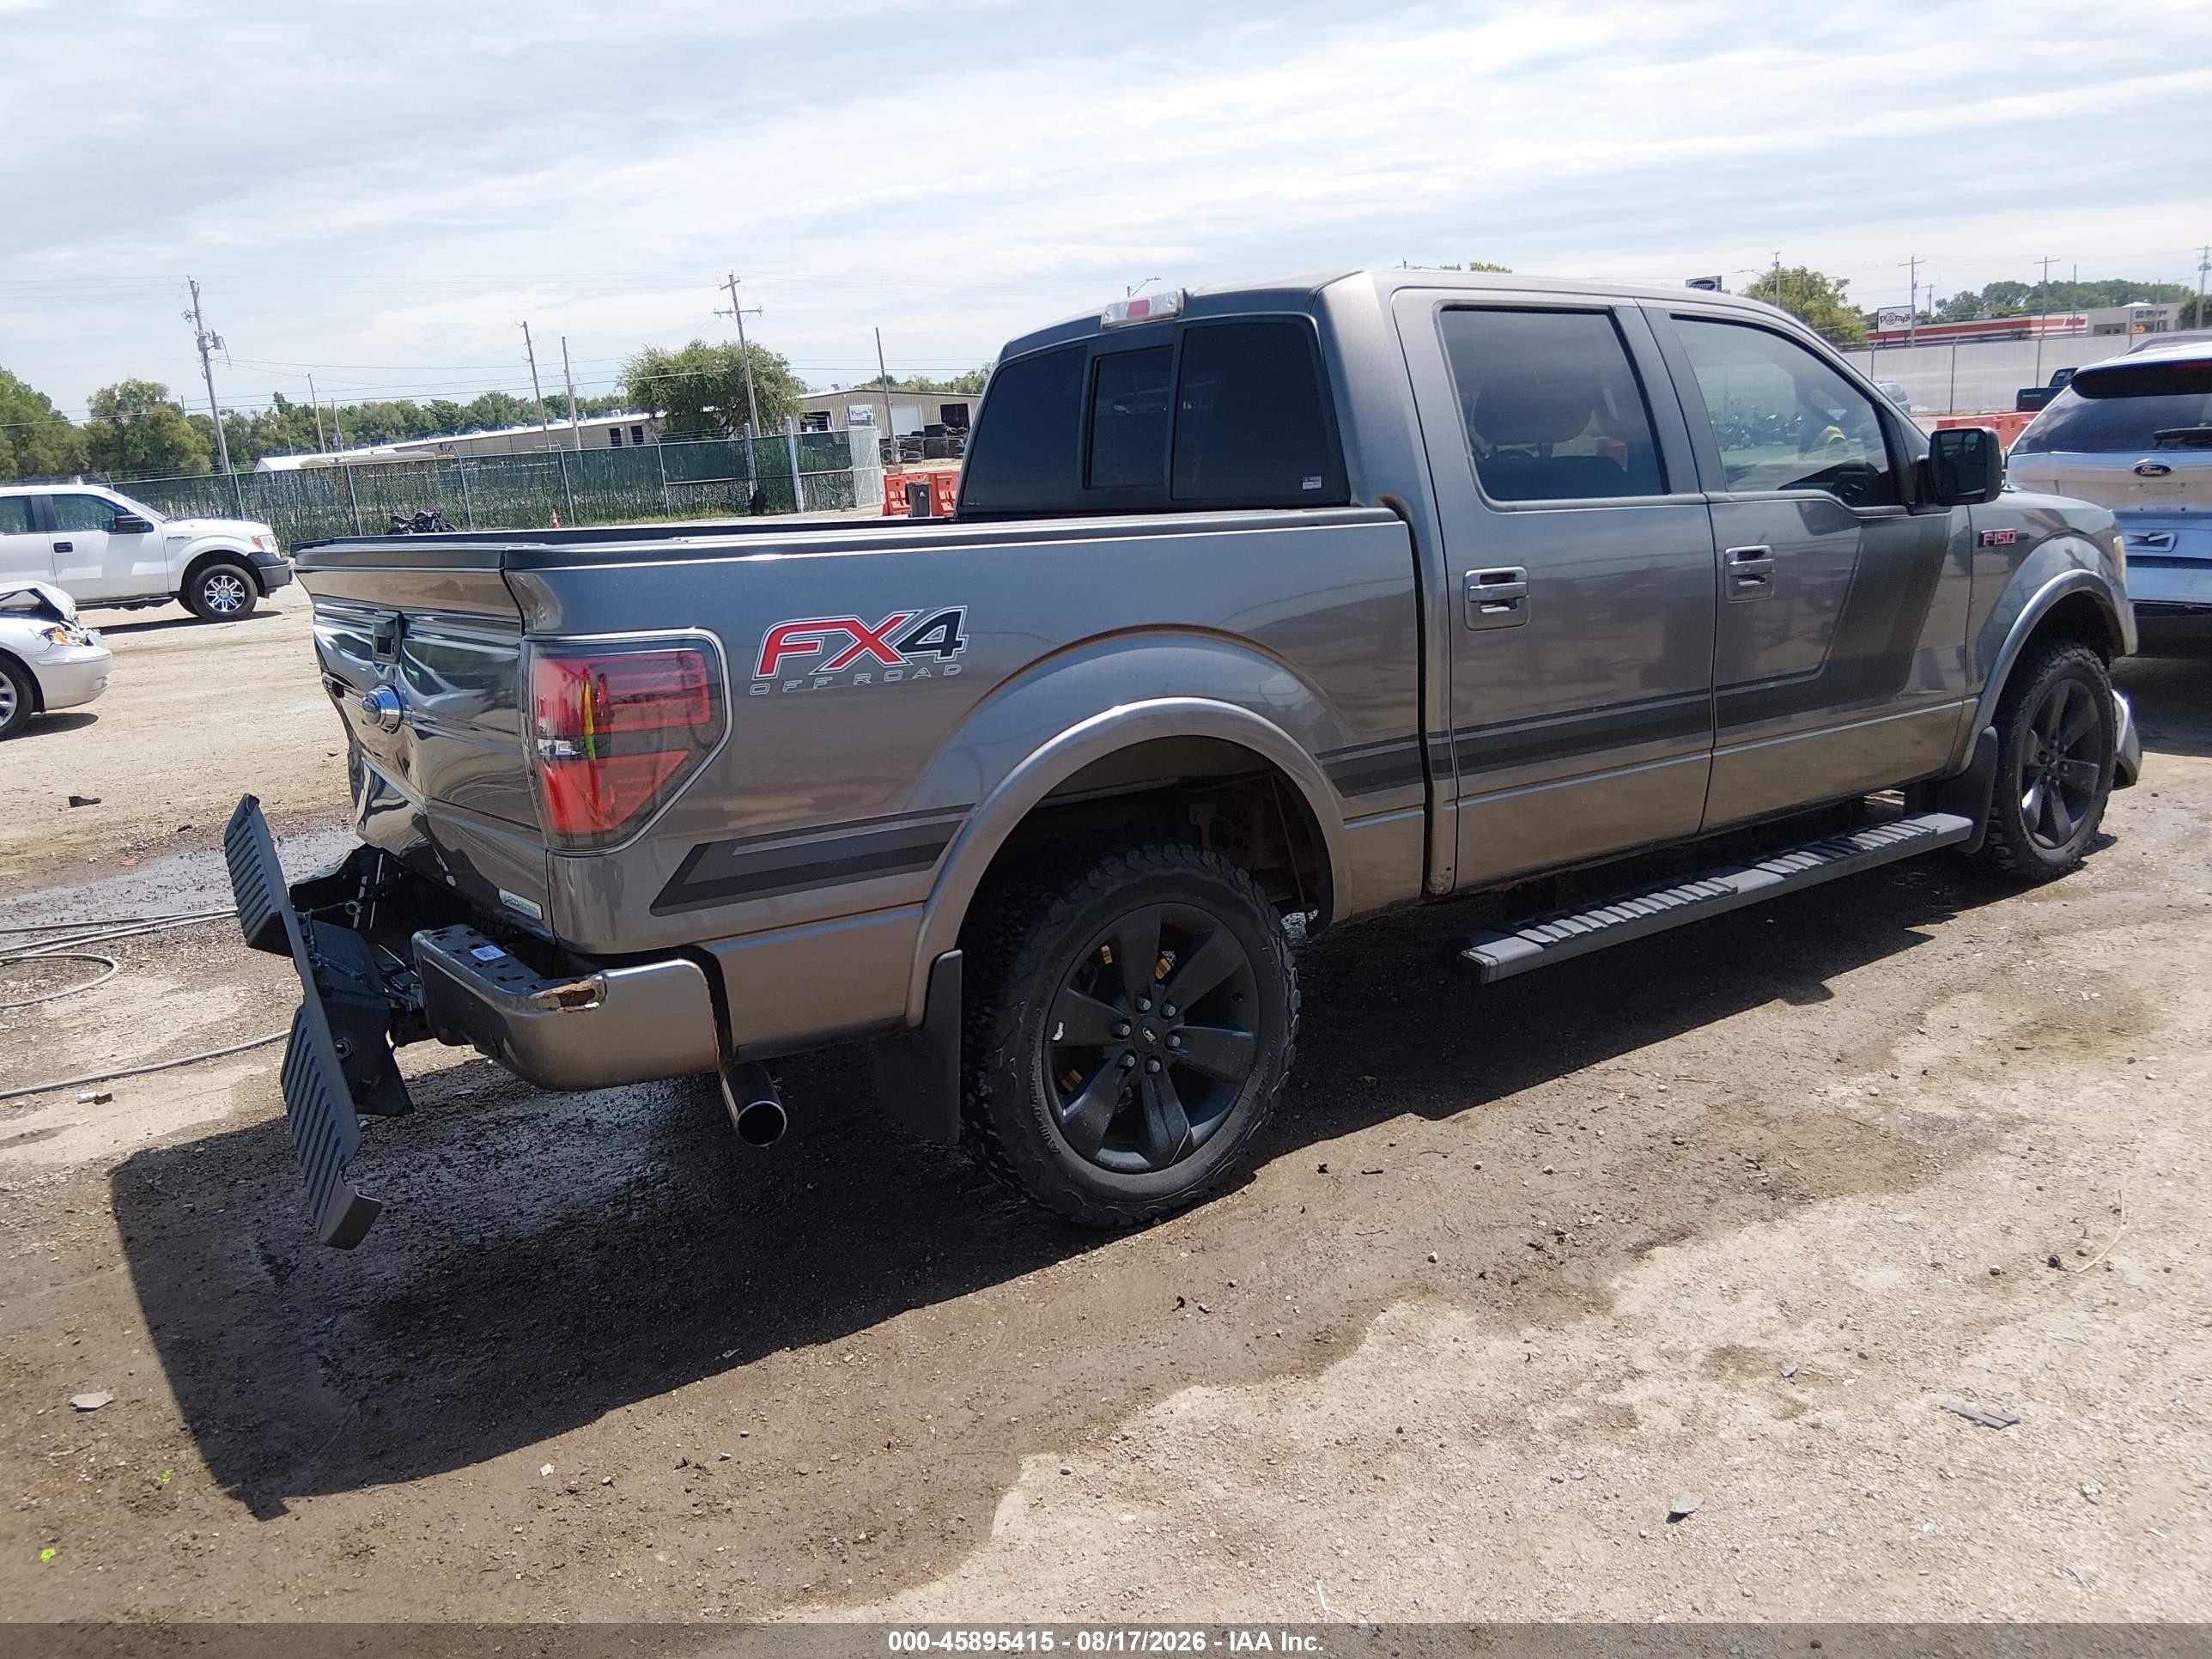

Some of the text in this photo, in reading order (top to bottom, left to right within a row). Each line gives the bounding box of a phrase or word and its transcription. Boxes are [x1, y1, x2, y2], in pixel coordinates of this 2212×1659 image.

[751, 605, 969, 680] FX4
[749, 664, 963, 696] OFF ROAD
